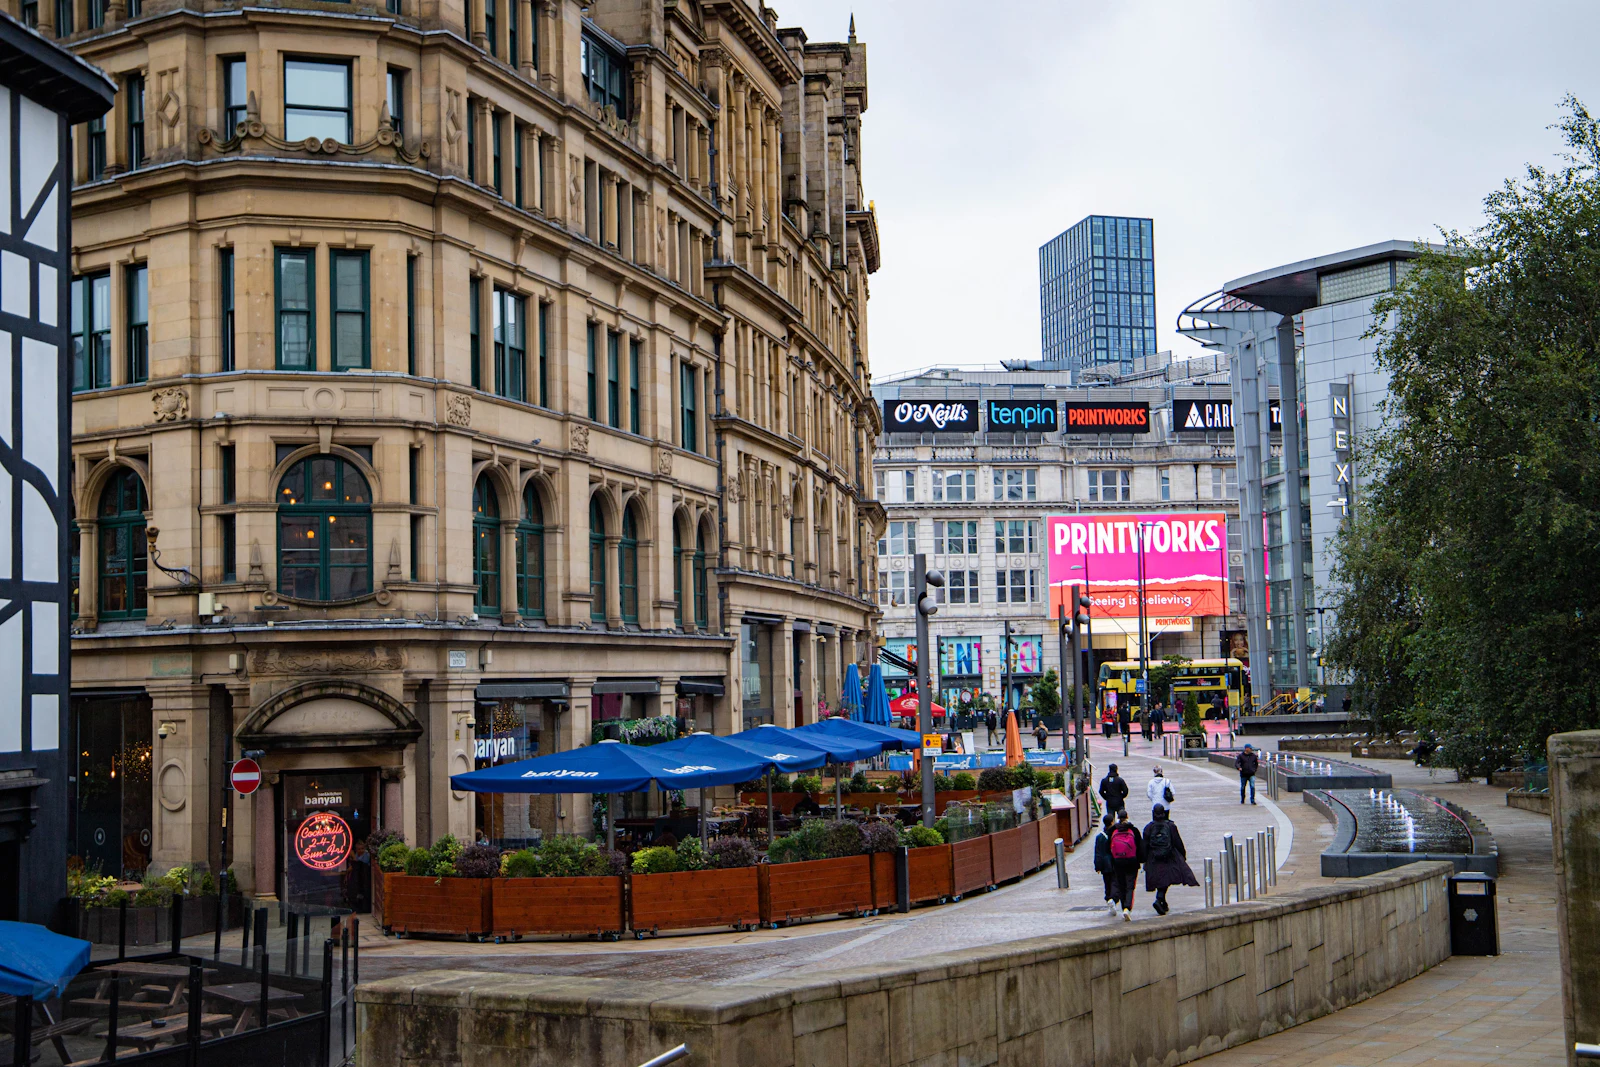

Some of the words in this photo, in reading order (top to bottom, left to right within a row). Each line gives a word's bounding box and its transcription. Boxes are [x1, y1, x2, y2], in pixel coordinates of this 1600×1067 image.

[894, 402, 969, 428] O'Neill's
[991, 402, 1054, 429] tenpin
[1068, 408, 1147, 426] PRINTWORKS
[1333, 397, 1348, 515] NEXT
[1054, 519, 1221, 555] PRINTWORKS
[1088, 596, 1126, 608] Seeing
[1129, 596, 1138, 605] is
[1155, 618, 1190, 626] PRINTWORKS
[305, 796, 342, 806] banyan
[301, 823, 344, 838] Cocktails
[309, 835, 336, 848] 2-4-1
